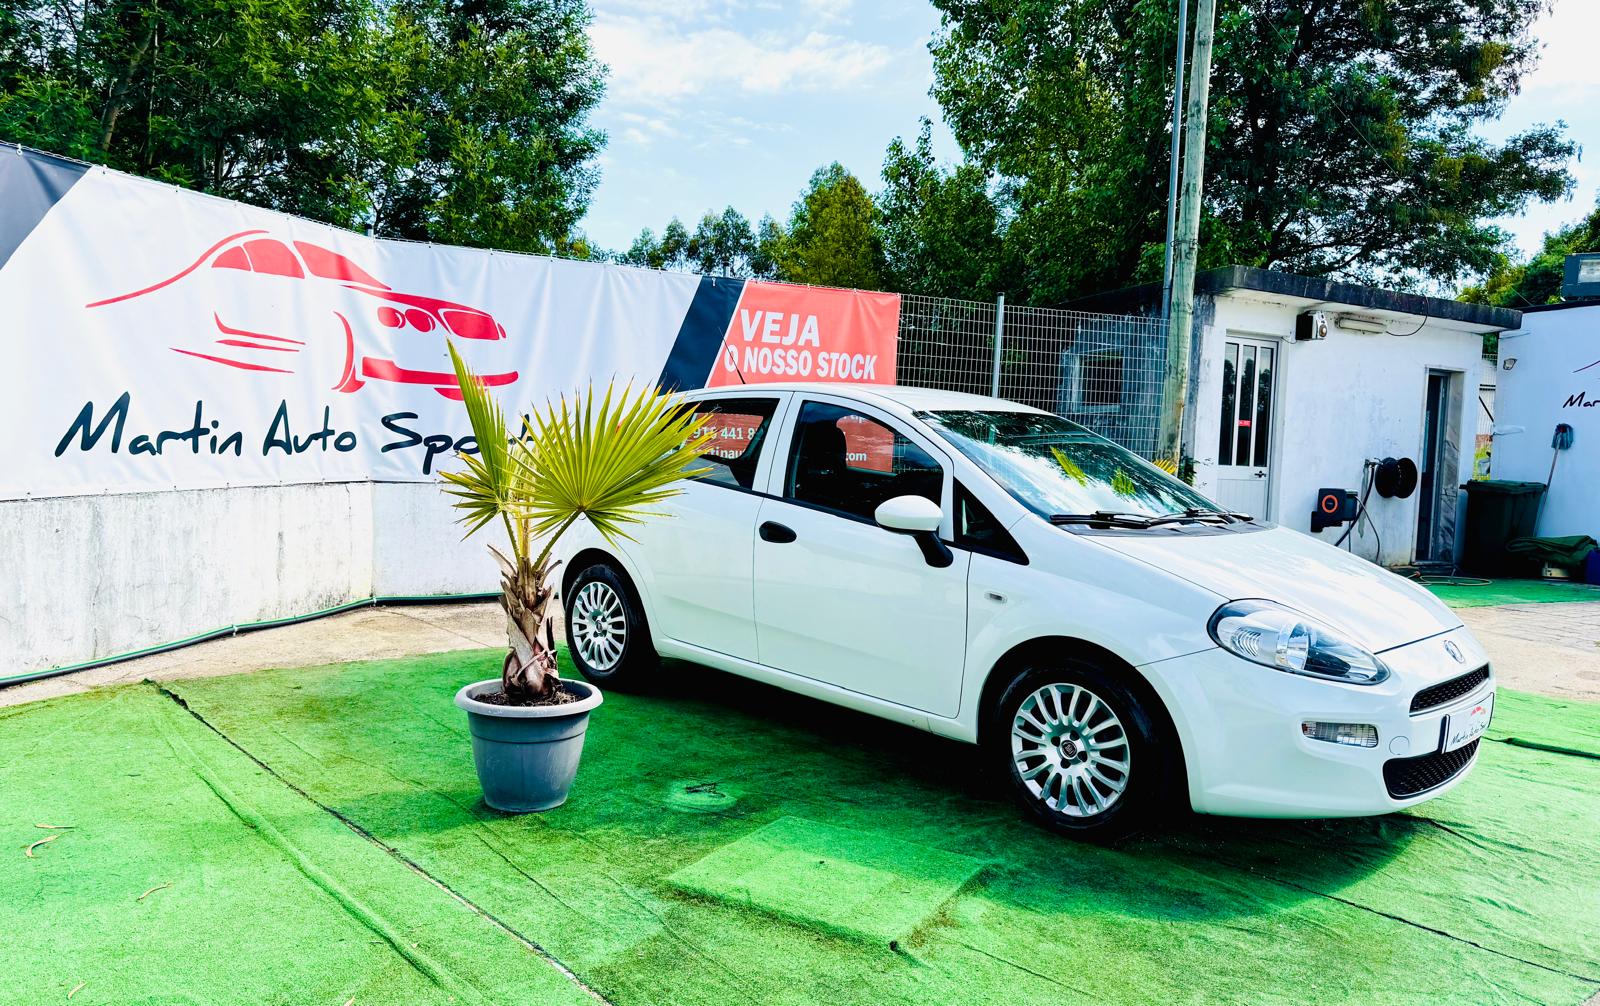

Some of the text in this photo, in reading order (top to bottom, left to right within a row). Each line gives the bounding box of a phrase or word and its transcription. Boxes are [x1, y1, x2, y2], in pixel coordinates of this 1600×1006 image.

[740, 308, 820, 347] VEJA
[724, 344, 878, 381] O NOSSO STOCK
[1562, 391, 1600, 408] Mar
[54, 390, 535, 475] Martin Auto Spot
[720, 427, 744, 440] 441
[747, 427, 757, 441] 8
